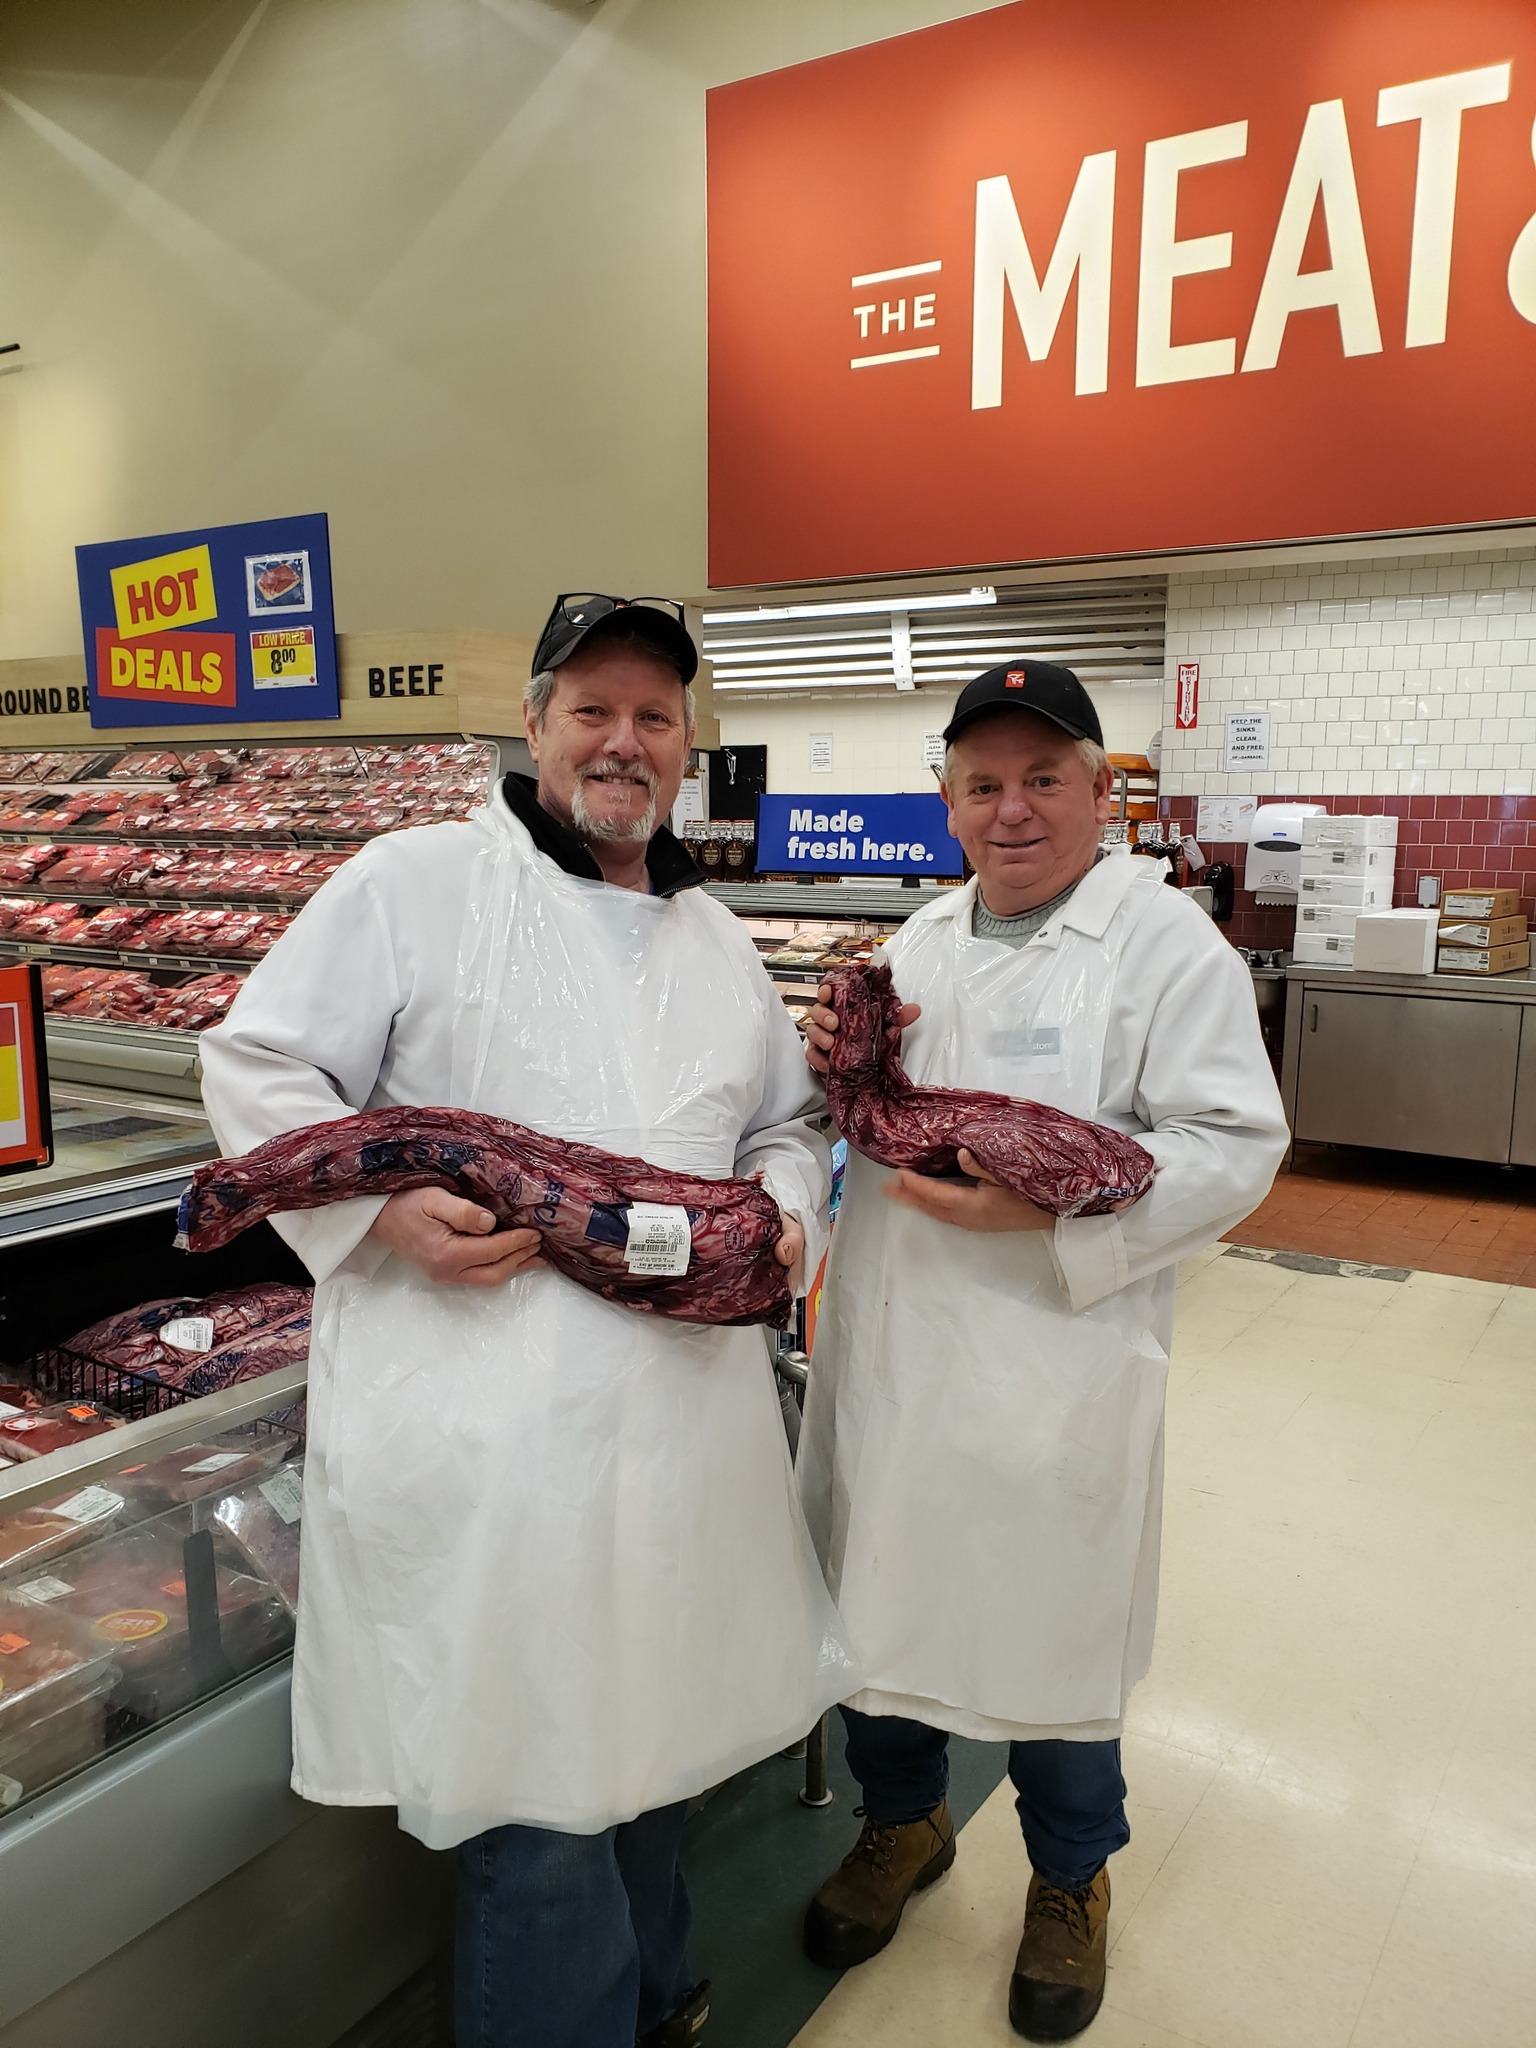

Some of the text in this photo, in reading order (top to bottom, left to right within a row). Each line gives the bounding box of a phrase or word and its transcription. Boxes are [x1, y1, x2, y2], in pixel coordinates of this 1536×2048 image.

[971, 60, 1511, 411] MEAT
[853, 293, 937, 339] THE
[126, 567, 199, 625] HOT
[259, 631, 306, 647] LOW PRICE
[110, 646, 223, 695] DEALS
[368, 663, 444, 698] BEEF
[788, 809, 864, 833] Made
[787, 835, 935, 862] fresh here.
